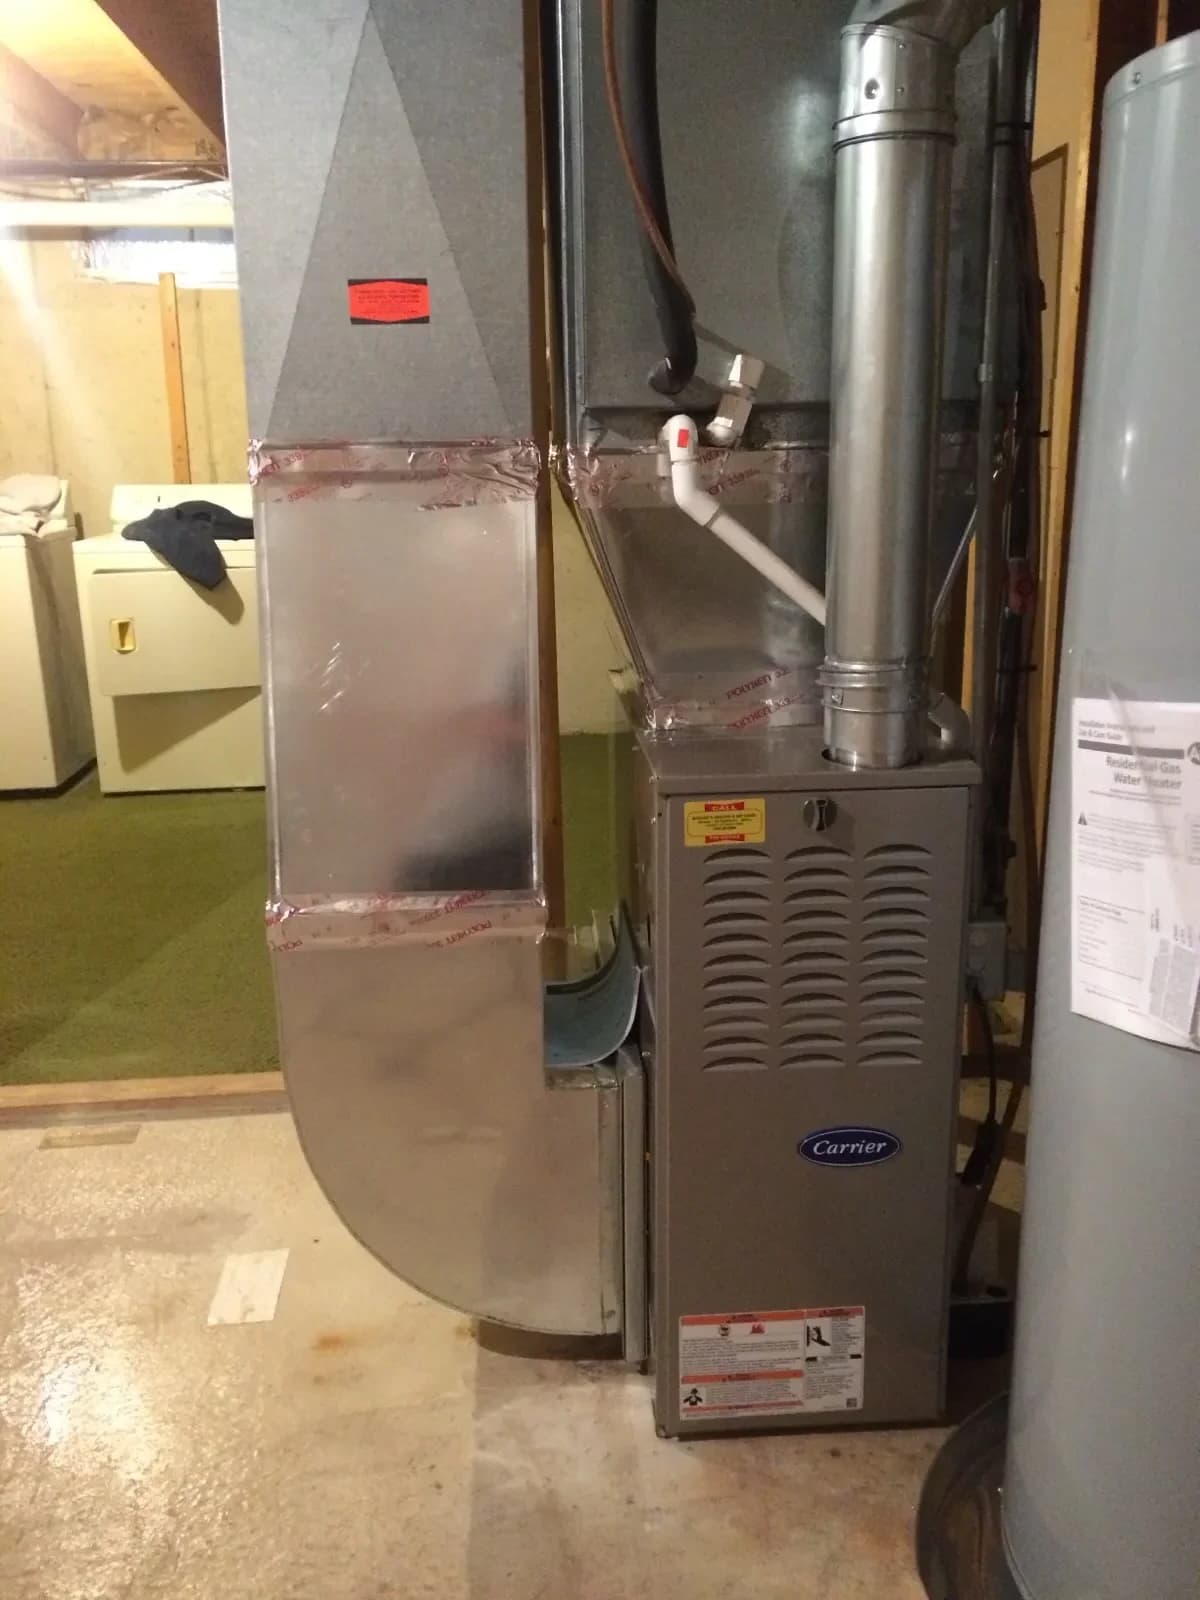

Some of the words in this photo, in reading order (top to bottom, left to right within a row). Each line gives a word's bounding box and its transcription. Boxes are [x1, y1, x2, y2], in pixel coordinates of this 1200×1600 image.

[1106, 756, 1158, 772] Residenal
[1160, 761, 1182, 774] Gas
[1113, 772, 1142, 786] Water
[812, 1139, 887, 1156] Carrier
